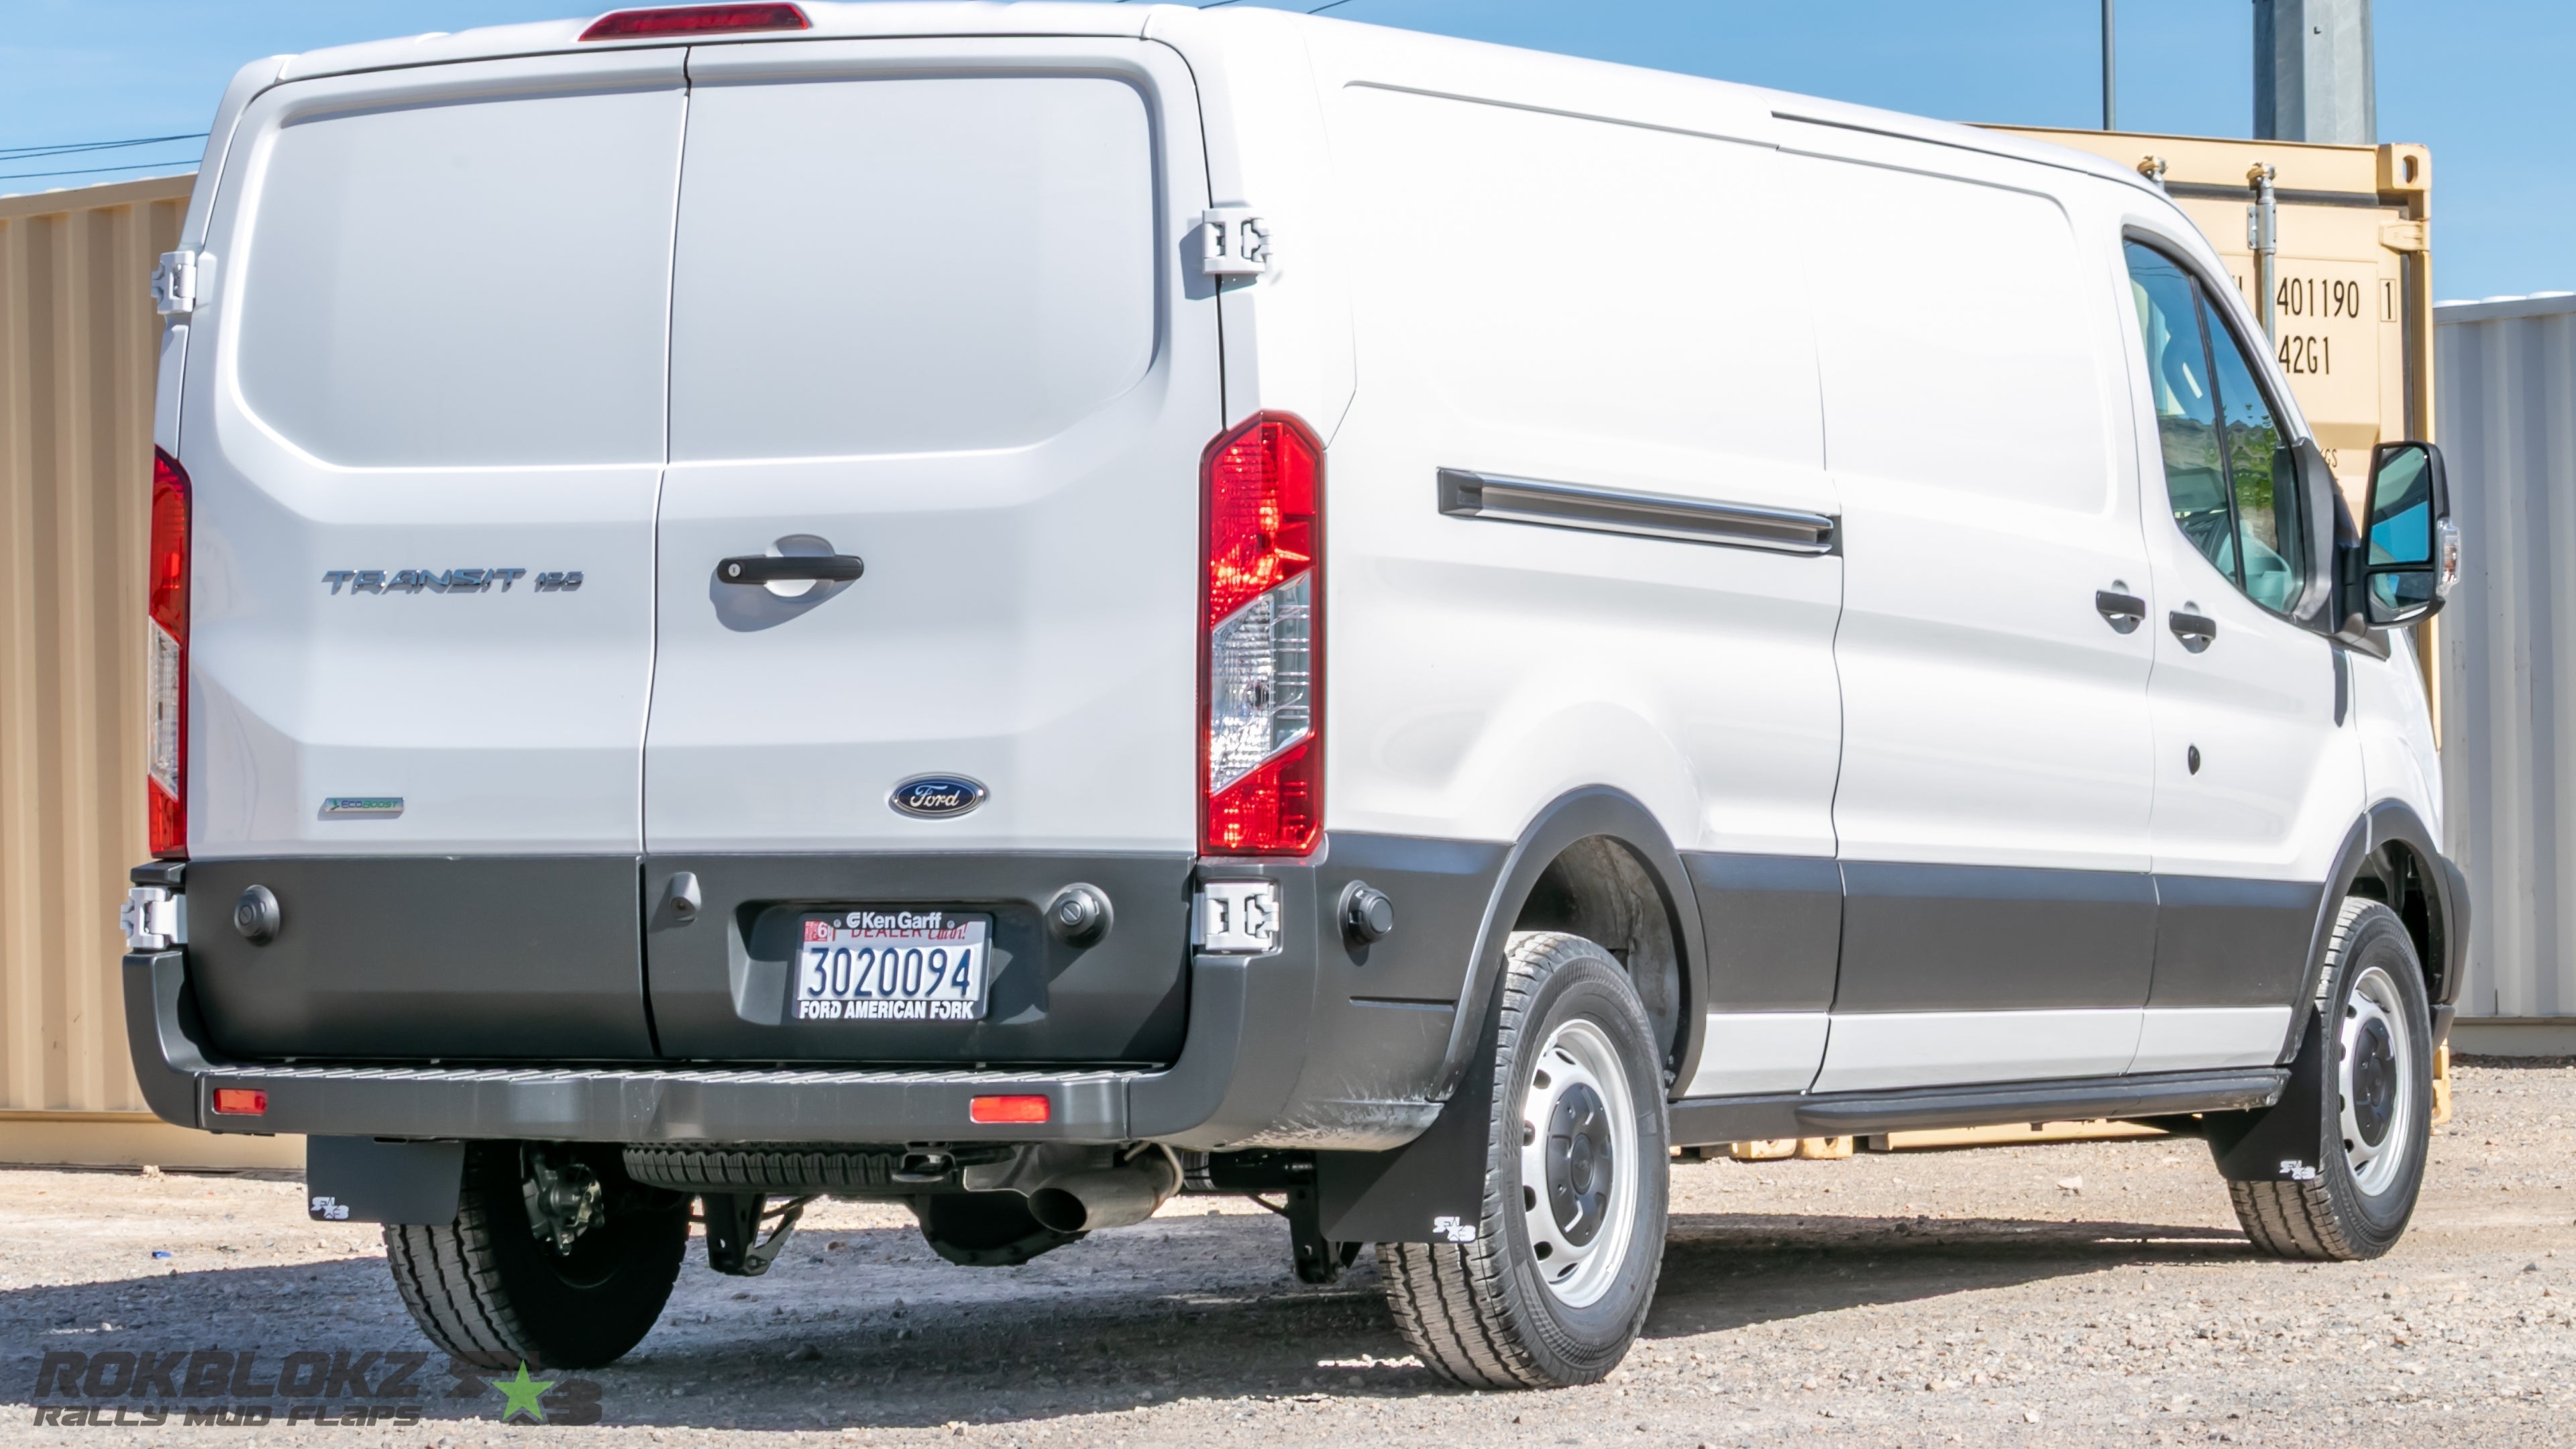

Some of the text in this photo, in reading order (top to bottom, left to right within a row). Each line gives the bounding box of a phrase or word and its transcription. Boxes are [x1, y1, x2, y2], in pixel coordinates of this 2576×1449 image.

[2277, 277, 2359, 318] 401190
[2278, 335, 2329, 375] 42G1
[325, 568, 584, 591] TRANSIT 150
[910, 784, 961, 808] Ford
[862, 912, 942, 929] Ken Garff
[808, 947, 971, 998] 3020094
[799, 1000, 974, 1019] FORD AMERICAN FORK
